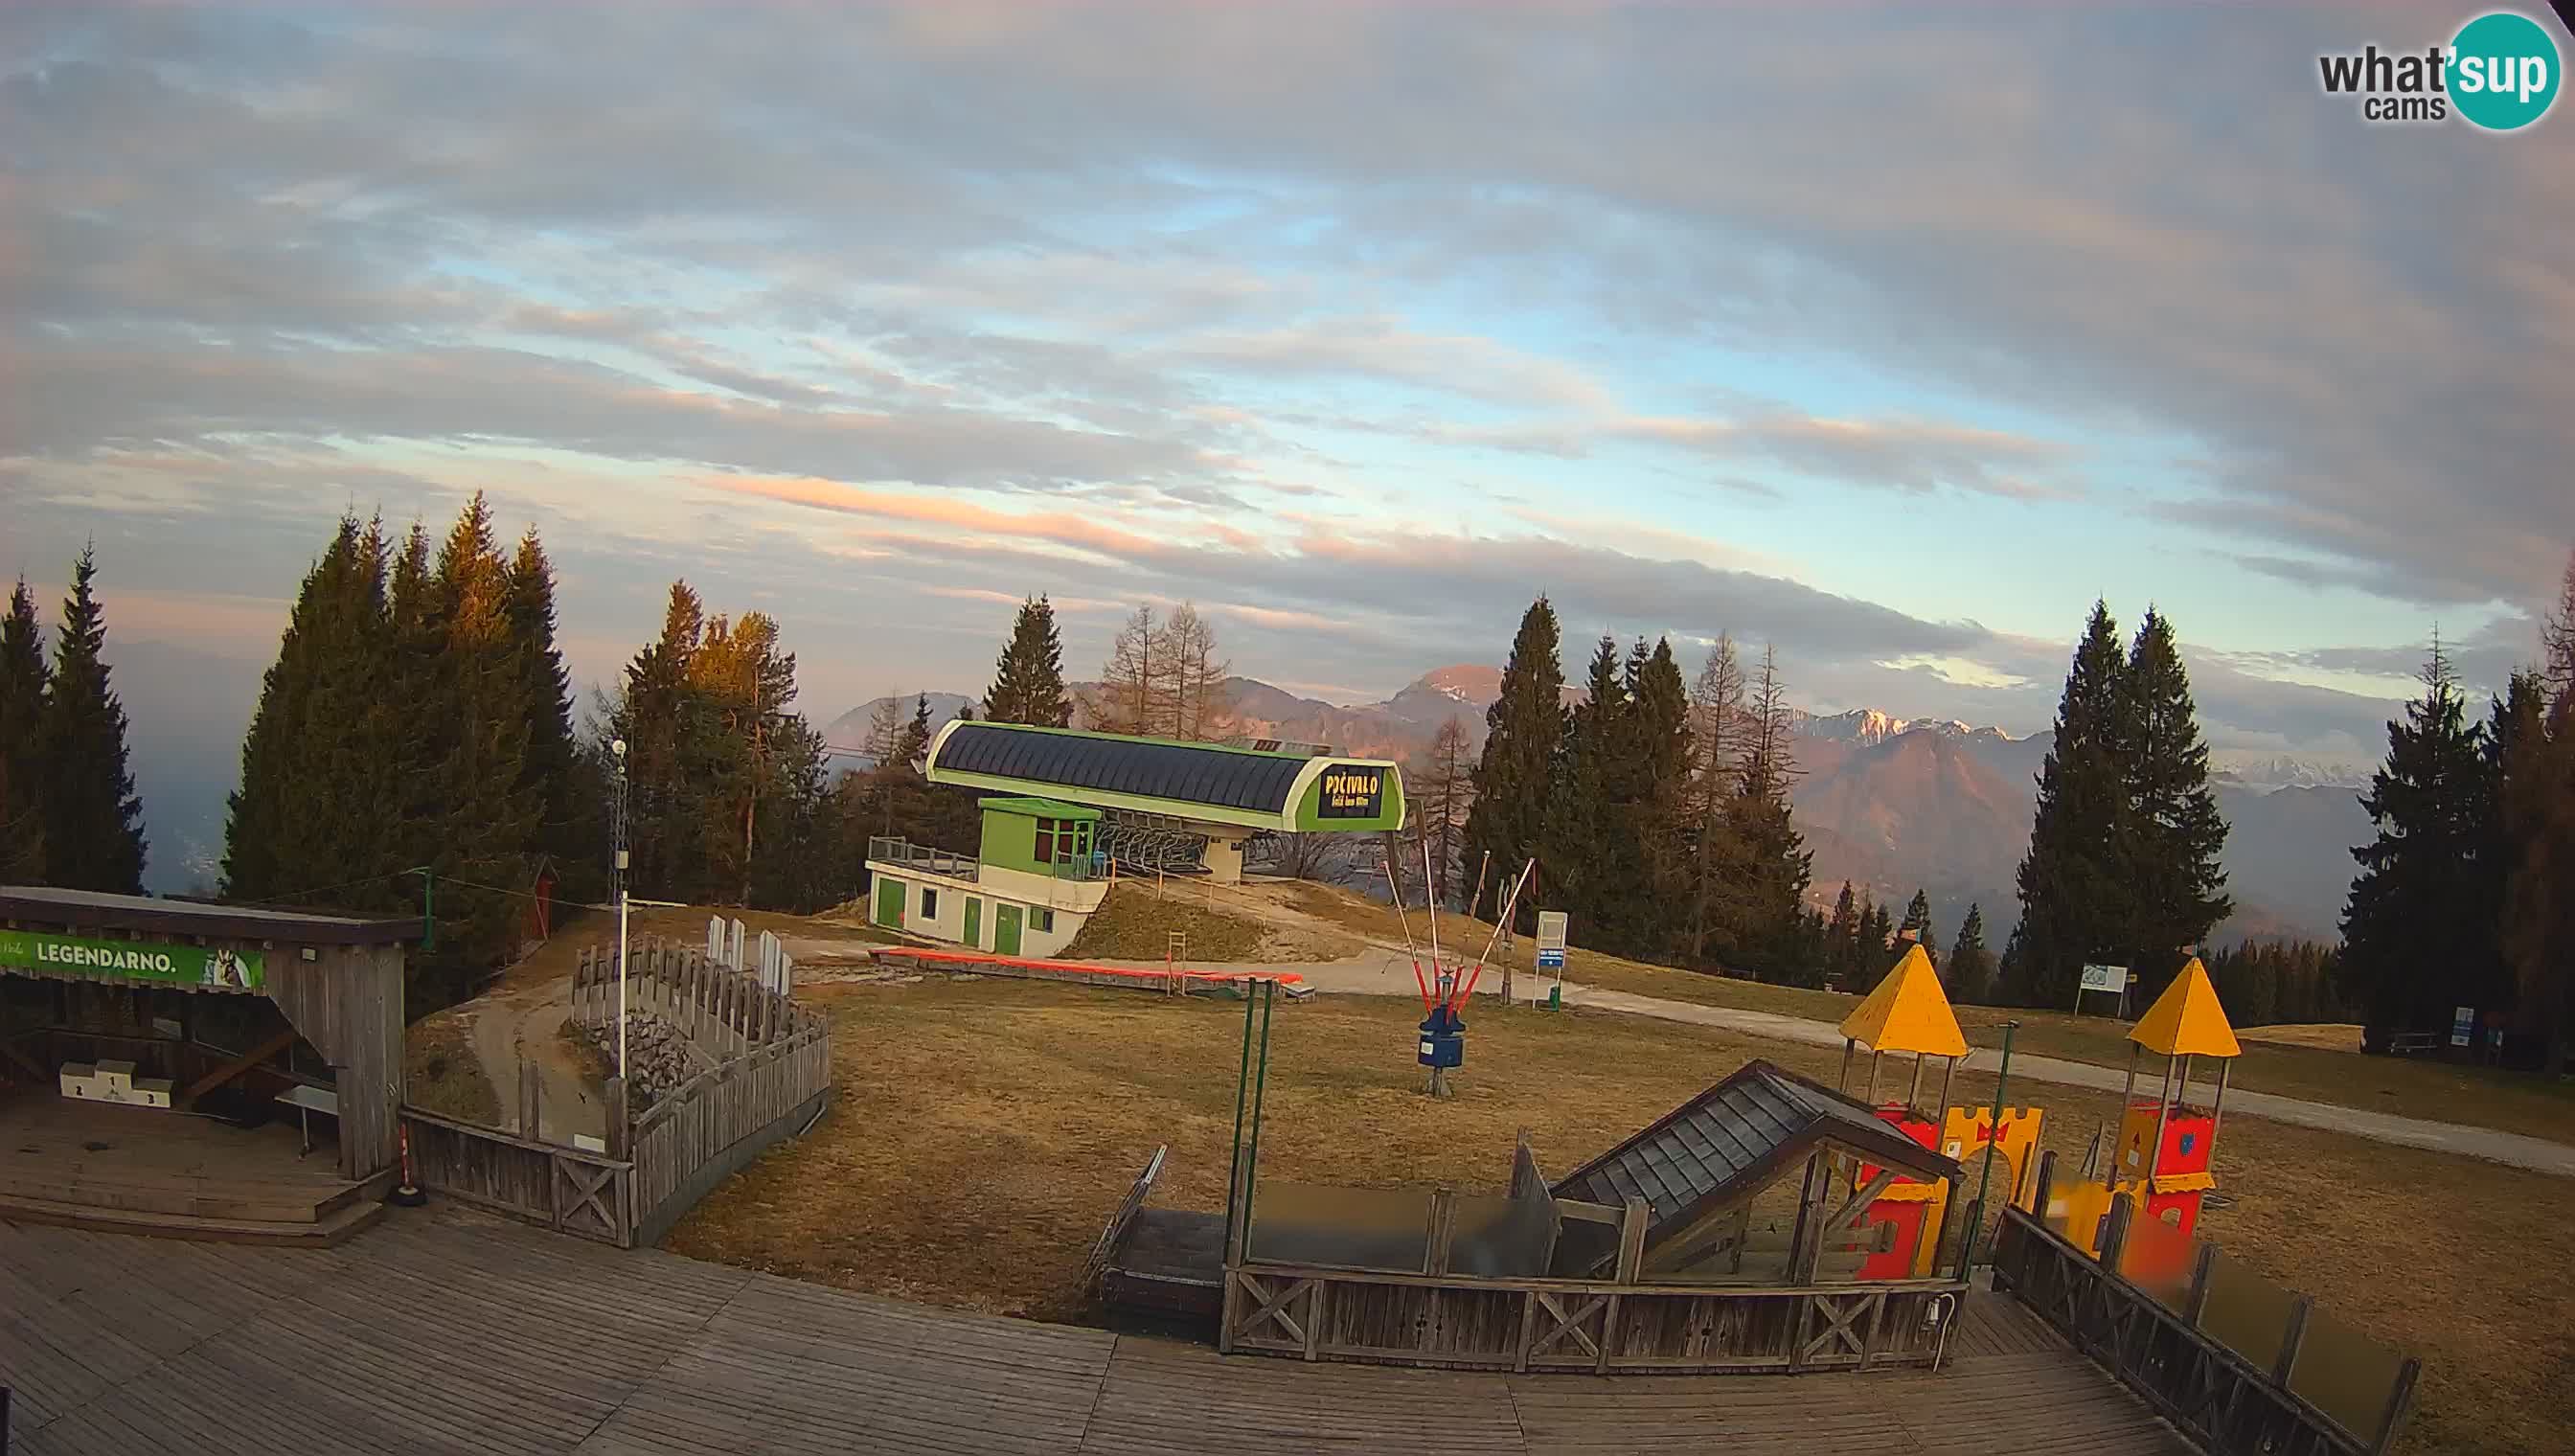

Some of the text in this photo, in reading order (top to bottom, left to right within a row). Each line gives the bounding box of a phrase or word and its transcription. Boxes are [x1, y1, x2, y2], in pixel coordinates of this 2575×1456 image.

[36, 942, 177, 973] LEGENDARNO.
[108, 1076, 115, 1086] 1
[76, 1085, 83, 1096] 2
